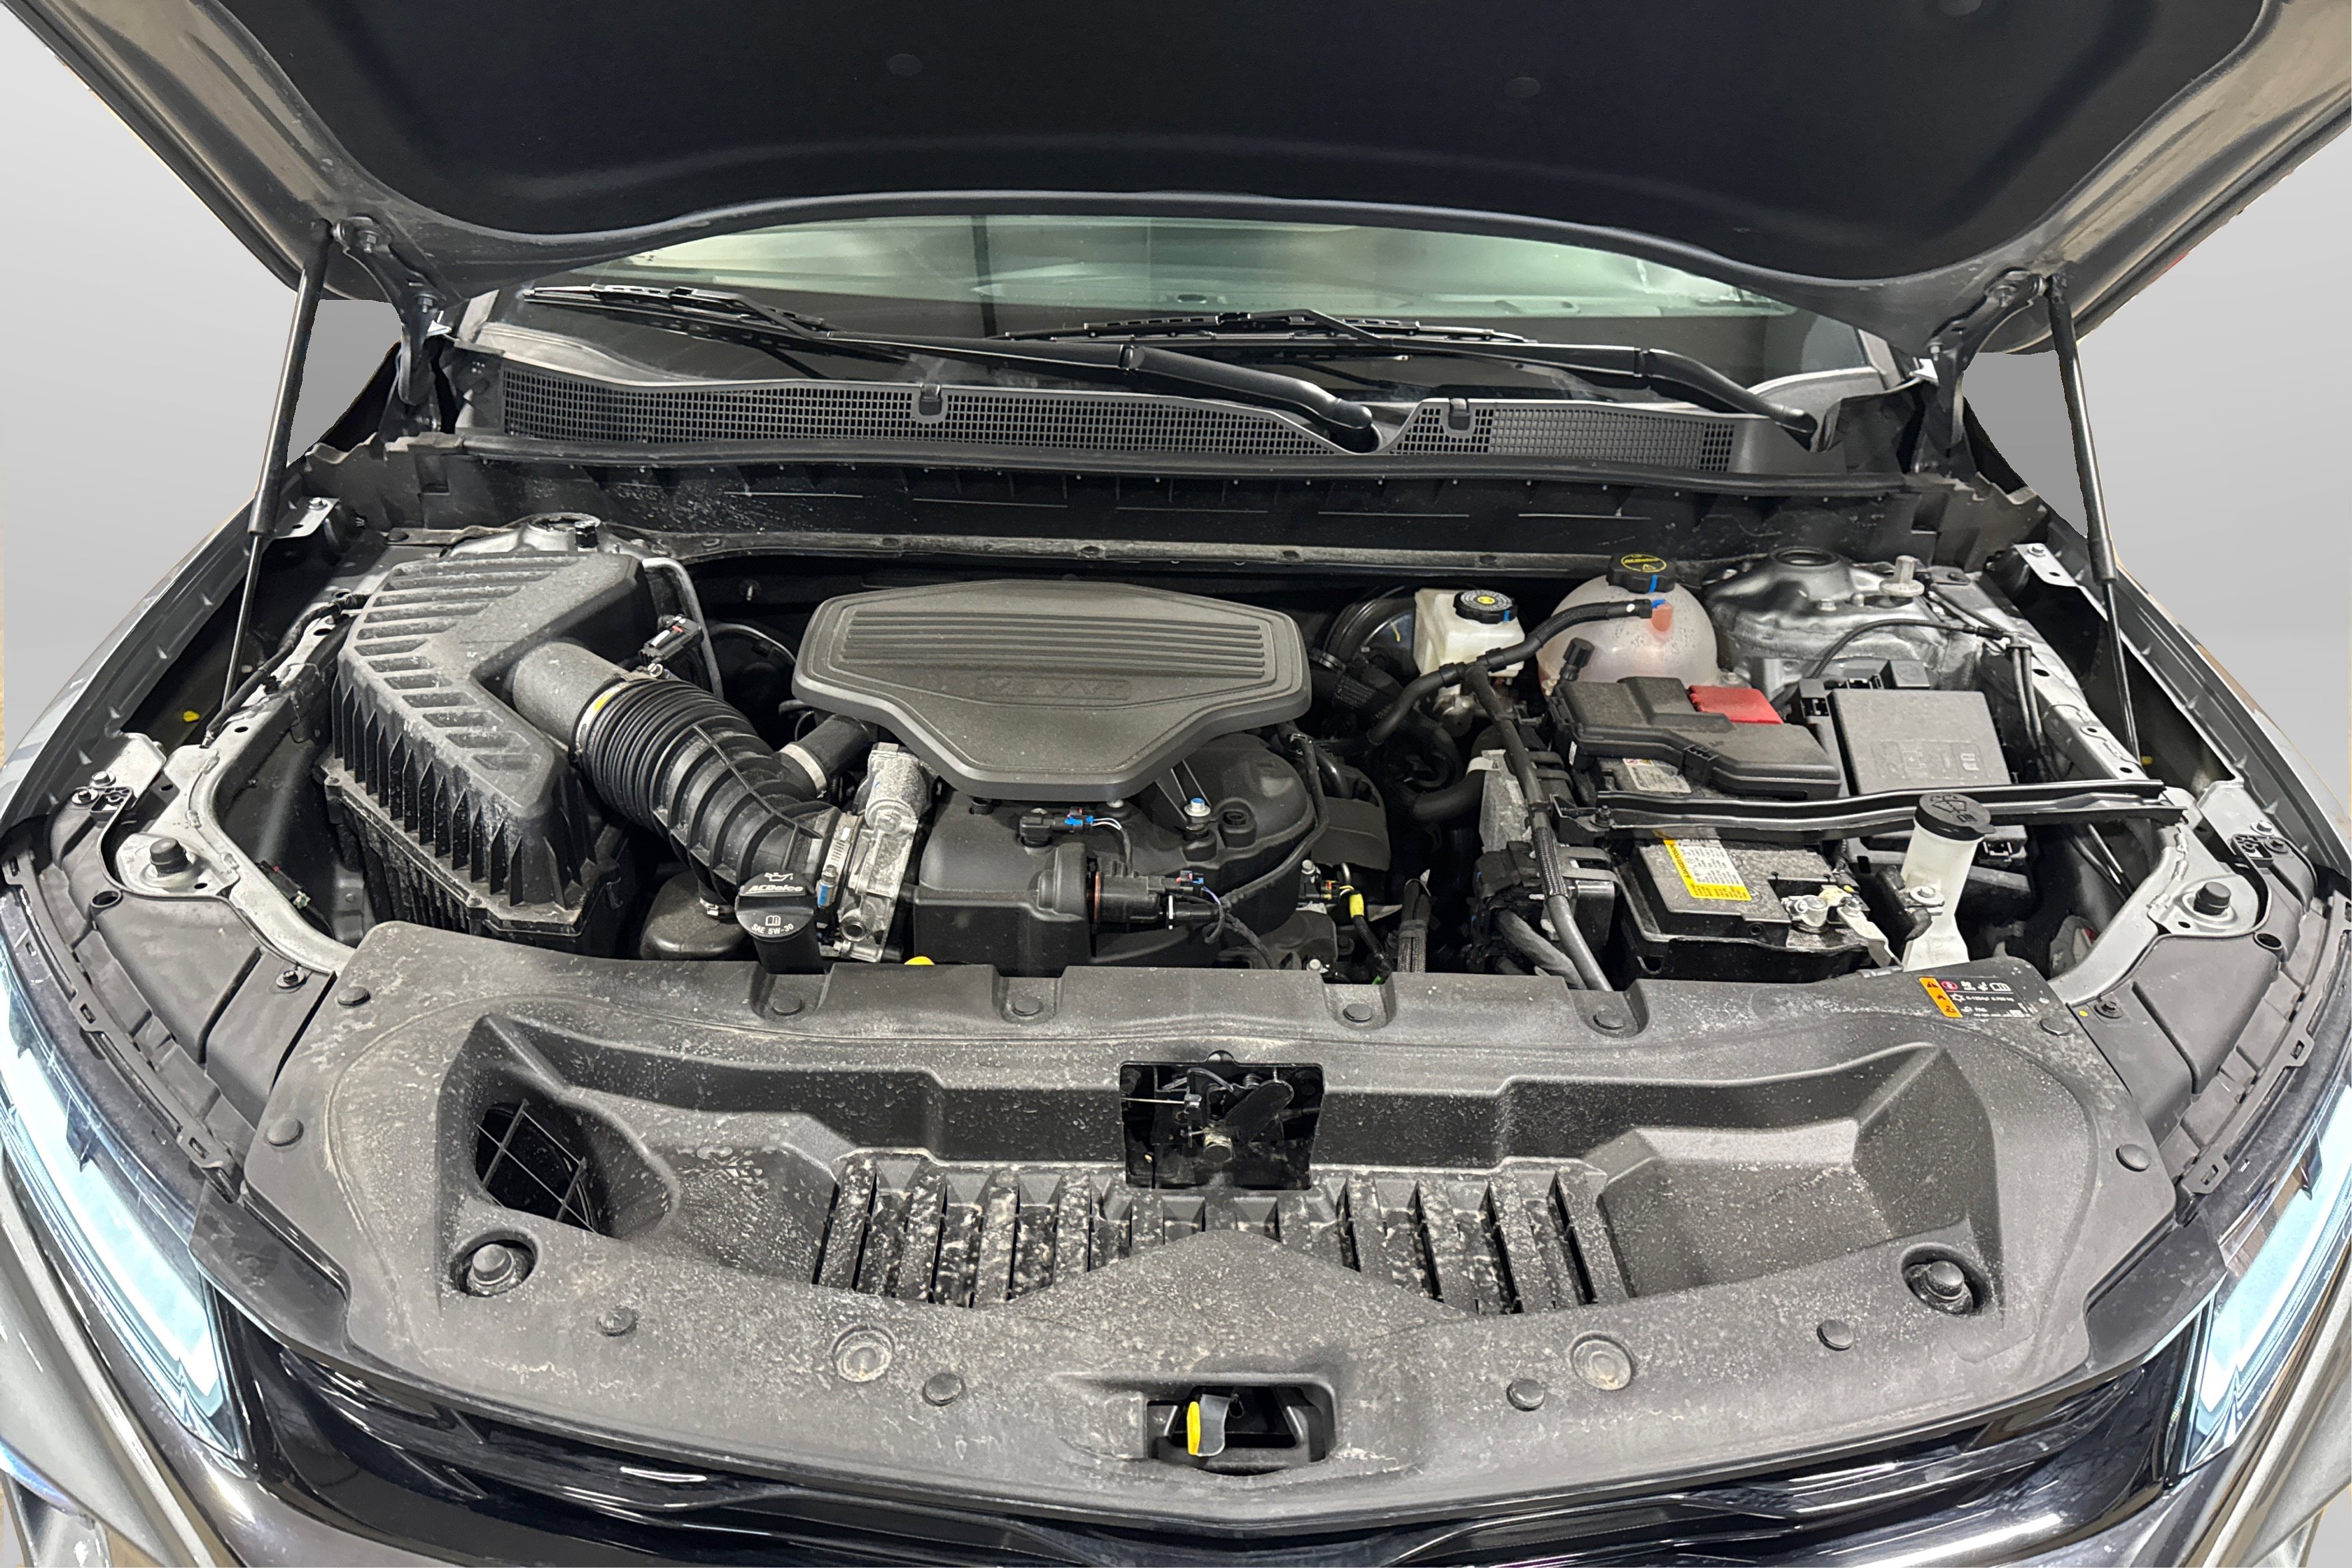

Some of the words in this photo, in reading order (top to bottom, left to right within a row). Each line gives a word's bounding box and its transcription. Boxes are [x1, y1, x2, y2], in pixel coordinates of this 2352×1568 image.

[747, 884, 804, 892] ACDelco
[751, 923, 766, 934] SAE
[767, 923, 794, 935] 5W-30
